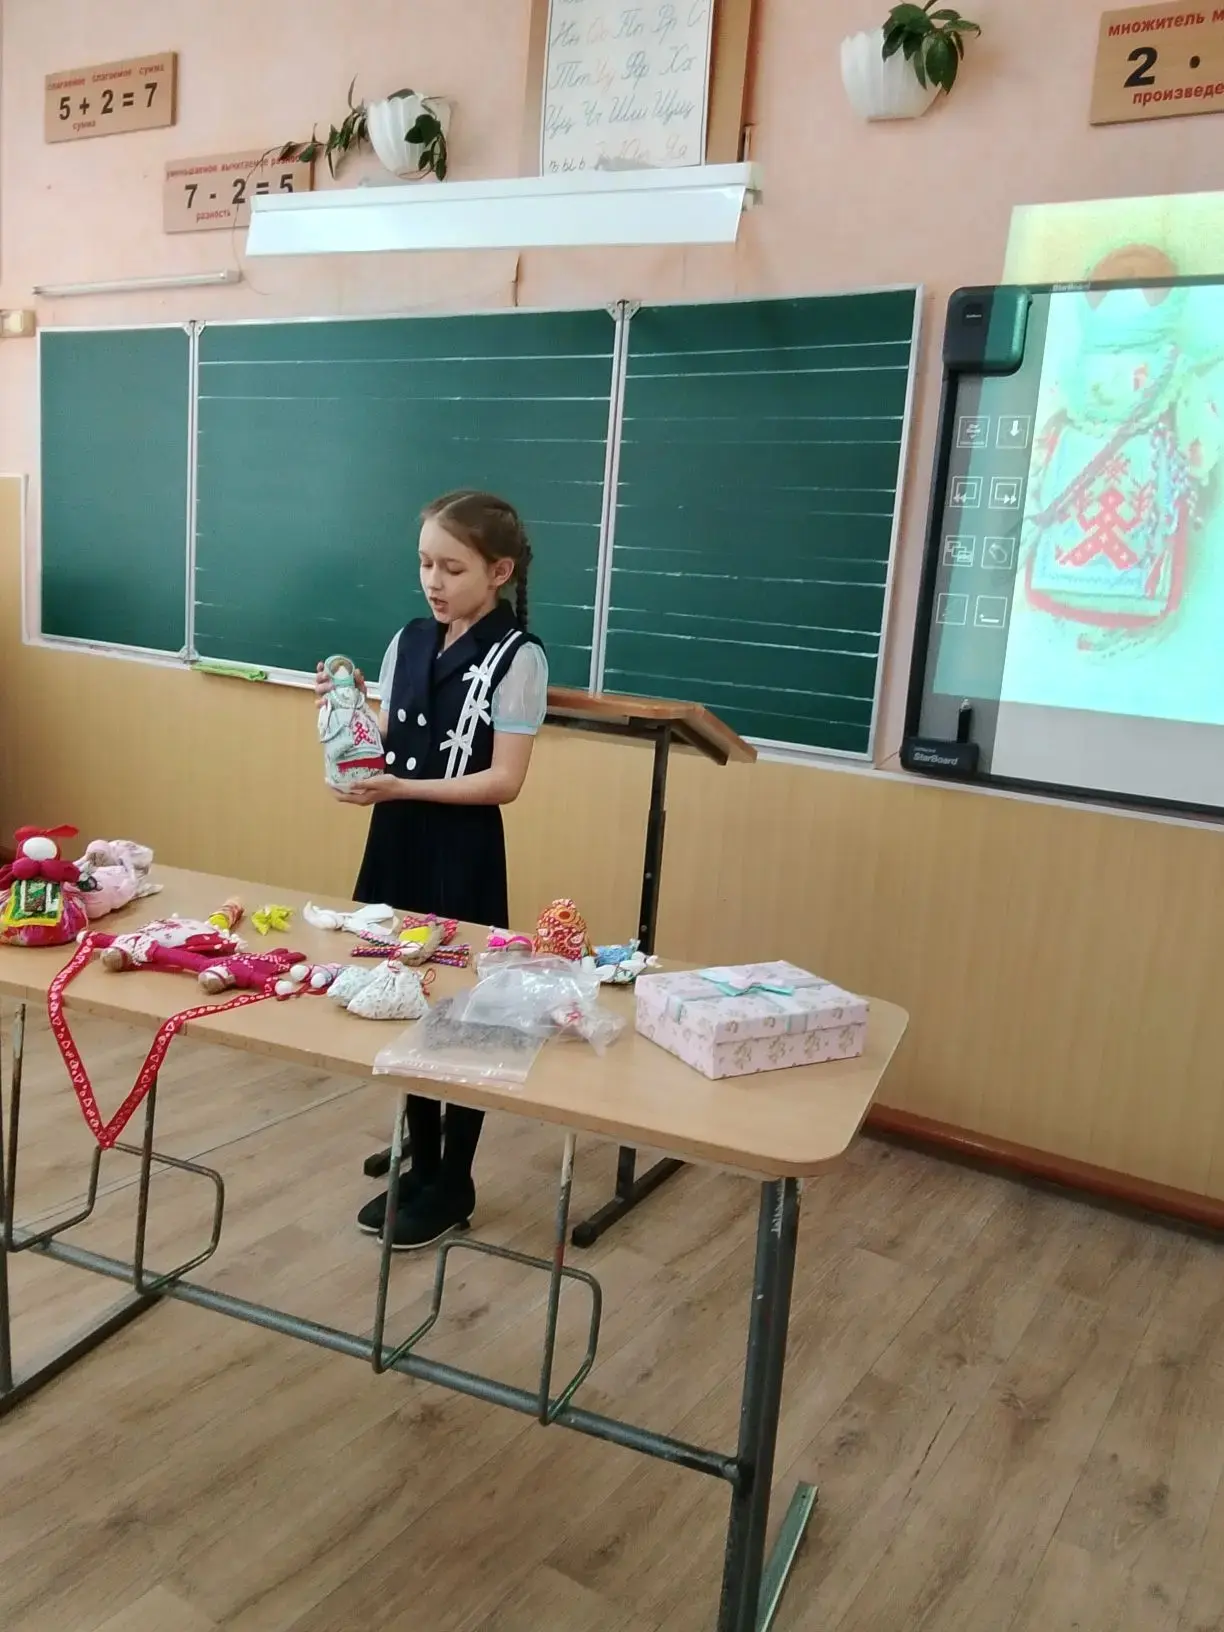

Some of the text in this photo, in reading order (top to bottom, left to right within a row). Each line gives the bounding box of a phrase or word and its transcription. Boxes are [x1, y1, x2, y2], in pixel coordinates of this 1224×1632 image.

[1108, 13, 1205, 36] множитель
[1123, 46, 1158, 88] 2
[59, 96, 71, 120] 5
[101, 89, 114, 115] 2
[144, 82, 158, 108] 7
[185, 184, 198, 209] 7
[232, 178, 246, 205] 2
[196, 209, 231, 223] разность
[913, 752, 959, 766] StarBoard
